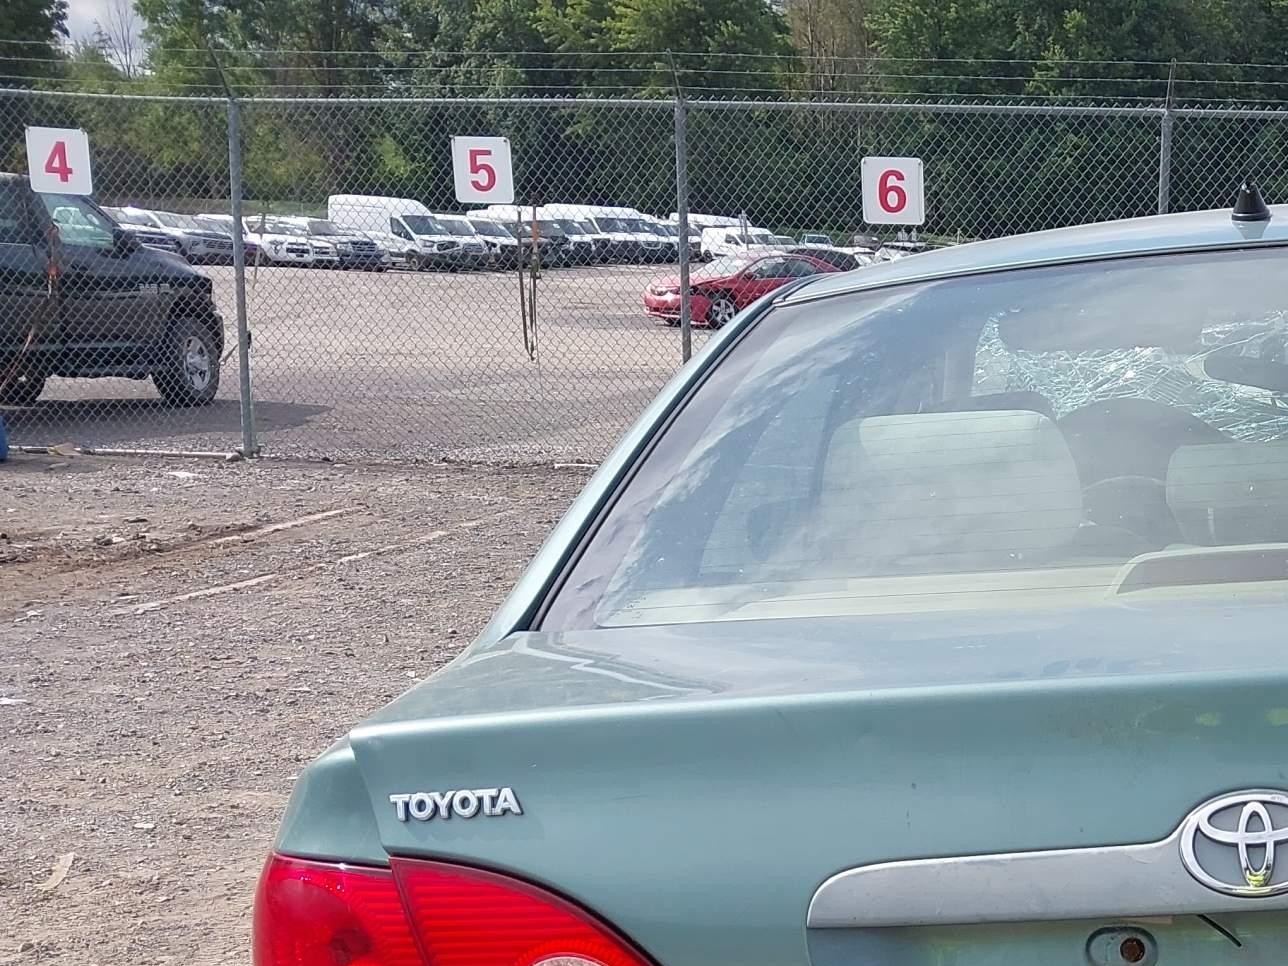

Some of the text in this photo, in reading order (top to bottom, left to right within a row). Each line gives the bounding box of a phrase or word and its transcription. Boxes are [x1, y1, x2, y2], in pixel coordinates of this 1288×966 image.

[45, 142, 73, 182] 4
[468, 149, 497, 192] 5
[877, 170, 907, 213] 6
[389, 787, 523, 822] TOYOTA
